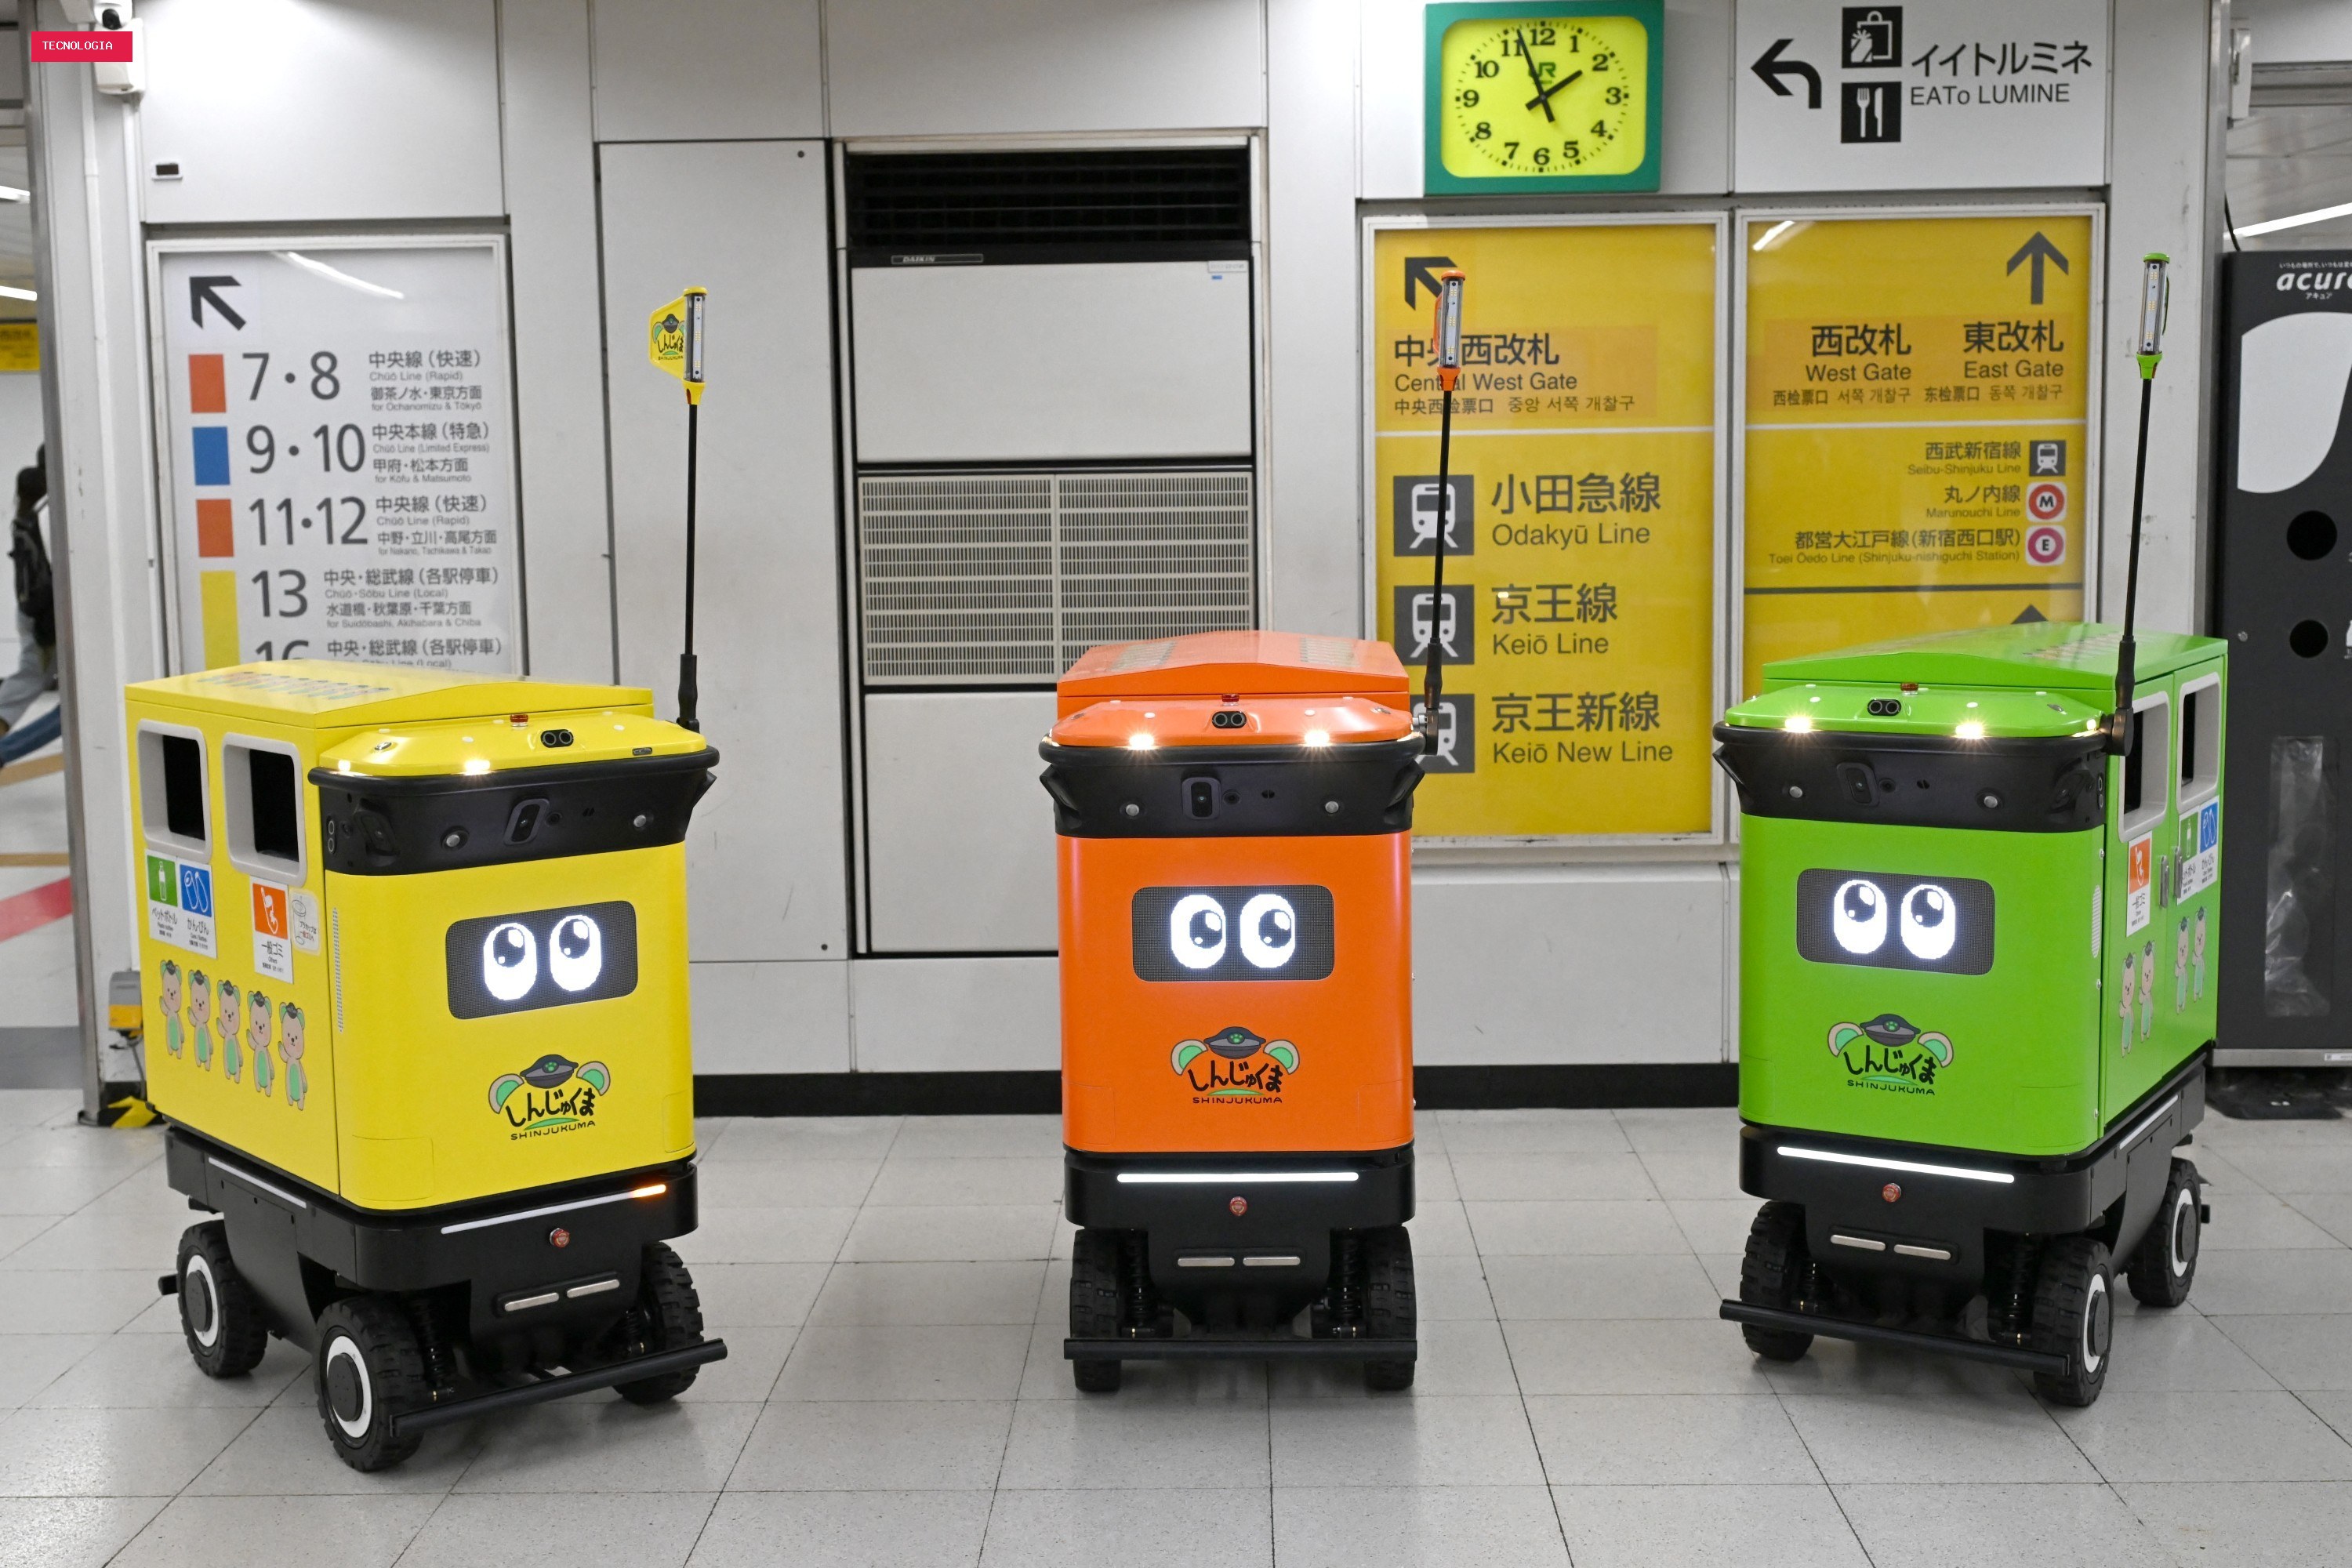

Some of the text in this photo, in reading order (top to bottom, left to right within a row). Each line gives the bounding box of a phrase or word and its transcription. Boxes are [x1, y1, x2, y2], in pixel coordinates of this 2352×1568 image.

[1530, 28, 1555, 45] 12
[1570, 35, 1579, 53] 1
[1501, 39, 1523, 56] 11
[1592, 54, 1608, 71] 2
[1911, 41, 2092, 77] イイトルミネ
[1475, 60, 1499, 78] 10
[1463, 90, 1479, 107] 9
[1606, 87, 1621, 104] 3
[1911, 83, 2070, 105] EATo LUMINE
[1475, 122, 1491, 140] 8
[1591, 120, 1607, 137] 4
[1504, 142, 1519, 159] 7
[1534, 147, 1550, 165] 6
[1563, 140, 1579, 158] 5
[1811, 323, 1911, 358] 西改札
[1963, 320, 2063, 354] 東改札
[368, 350, 481, 368] 中央線（快速）
[400, 371, 422, 380] Line
[426, 370, 463, 382] (Rapid)
[1806, 363, 1911, 382] West Gate
[1964, 360, 2063, 378] East Gate
[1395, 372, 1577, 392] Cental West Gate
[371, 386, 482, 400] 御茶ノ水・東京方面
[1838, 387, 1911, 405] 서쪽 개찰구
[1989, 384, 2063, 401] 동쪽 개찰구
[386, 402, 442, 411] Ochanomizu
[1508, 395, 1635, 414] 중앙 서쪽 개찰구
[372, 422, 488, 440] 中央本線（特急）
[397, 444, 415, 452] Line
[418, 443, 450, 453] (Limited
[453, 443, 490, 453] Express)
[1926, 441, 2021, 461] 西武新宿線
[373, 458, 468, 472] 甲府・松本方面
[1908, 463, 2021, 476] Seibu-Shinjuku Line
[376, 474, 387, 483] for
[422, 474, 471, 483] Matsumoto
[1491, 471, 1661, 514] 小田急線
[1944, 485, 2021, 504] 丸ノ内線
[2040, 495, 2054, 508] M
[376, 495, 487, 513] 中央線（快速）
[1926, 506, 2020, 518] Marunouchi Line
[407, 516, 429, 525] Line
[433, 515, 470, 526] (Rapid)
[377, 529, 497, 545] 中野・立川・高尾方面
[1492, 523, 1650, 550] Odakyū Line
[1795, 528, 2020, 550] 都営大江戸線(新宿西口駅)
[2042, 539, 2050, 551] E
[1769, 554, 1793, 564] Toei
[1831, 553, 1855, 563] Line
[1859, 550, 1973, 564] (Shinjuku-nishiguchi
[1976, 550, 2020, 562] Station)
[324, 567, 498, 586] 中央・総武線（各駅停車）
[251, 568, 308, 618] 13
[389, 589, 410, 598] Line
[414, 588, 448, 599] (Local)
[326, 601, 472, 616] 水道橋・秋葉原・千葉方面
[1491, 582, 1618, 625] 京王線
[397, 619, 443, 627] Akihabara
[455, 618, 481, 626] Chiba
[327, 638, 501, 657] 中央・総武線（各駅停車）
[1493, 633, 1609, 655] Keiō Line
[1491, 691, 1661, 734] 京王新線
[1494, 742, 1673, 764] Keiō New Line
[1843, 1045, 1936, 1085] しんじゅくま
[1187, 1060, 1283, 1093] しんじゅくま
[1847, 1080, 1935, 1096] SHINJUKUMA
[506, 1087, 596, 1127] しんじゅくま
[510, 1120, 596, 1141] SHINJUKUMA
